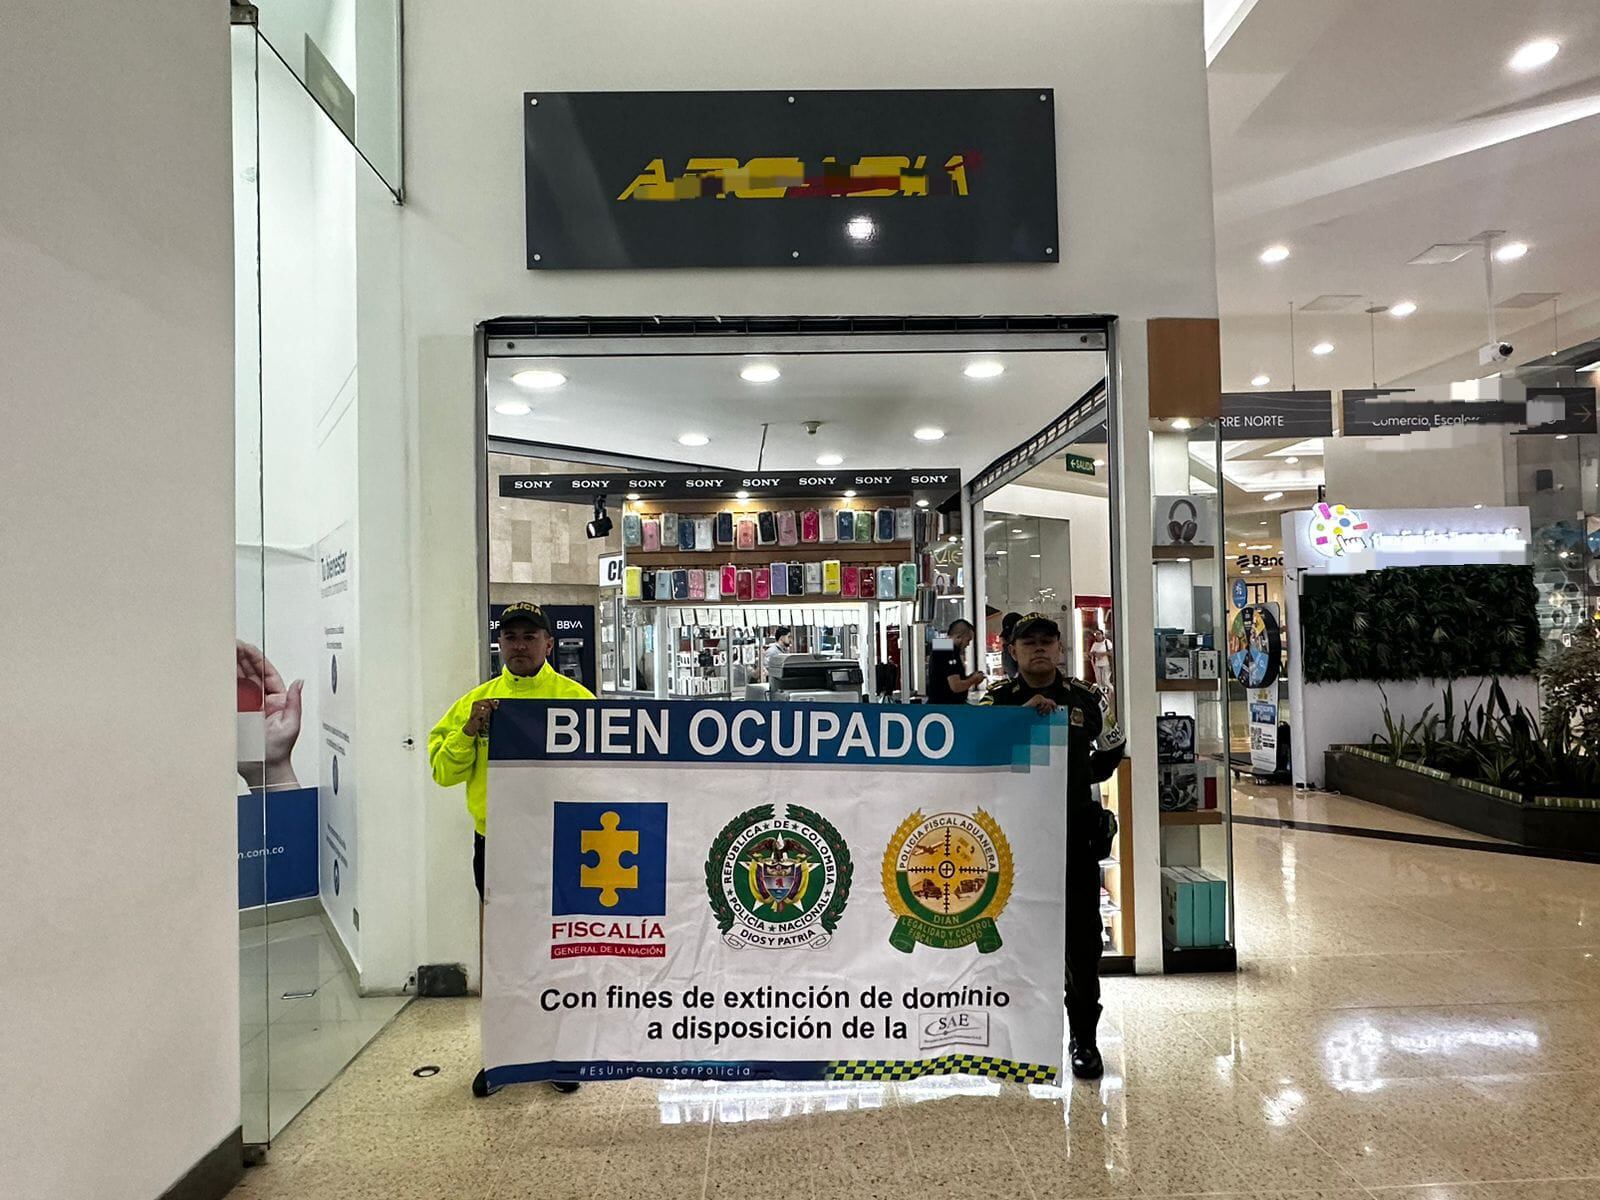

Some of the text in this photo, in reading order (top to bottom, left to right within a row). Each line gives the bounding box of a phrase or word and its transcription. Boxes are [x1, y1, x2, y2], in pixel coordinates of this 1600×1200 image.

[1244, 416, 1284, 427] NORTE
[514, 475, 949, 489] SONY SONY SONY SONY SONY SONY SONY SONY
[556, 620, 583, 630] BBVA
[545, 708, 955, 760] BIEN OCUPADO
[774, 820, 790, 829] DE
[801, 827, 835, 885] COLOMBIA
[925, 817, 958, 832] FISCAL
[960, 820, 996, 870] ADUANERA
[778, 897, 830, 932] NACIONAL
[933, 915, 960, 925] DIAN
[551, 919, 665, 939] FISCALÍA
[740, 929, 816, 946] DIOS Y PATRIA
[901, 917, 946, 939] LEGALIDAD
[956, 919, 992, 938] CONTROL
[554, 945, 664, 956] GENERAL DE LA NACIÓN
[540, 985, 1010, 1012] Con fines de extinción de dominio
[647, 1016, 908, 1045] a disposición de la
[938, 1013, 970, 1030] SAE
